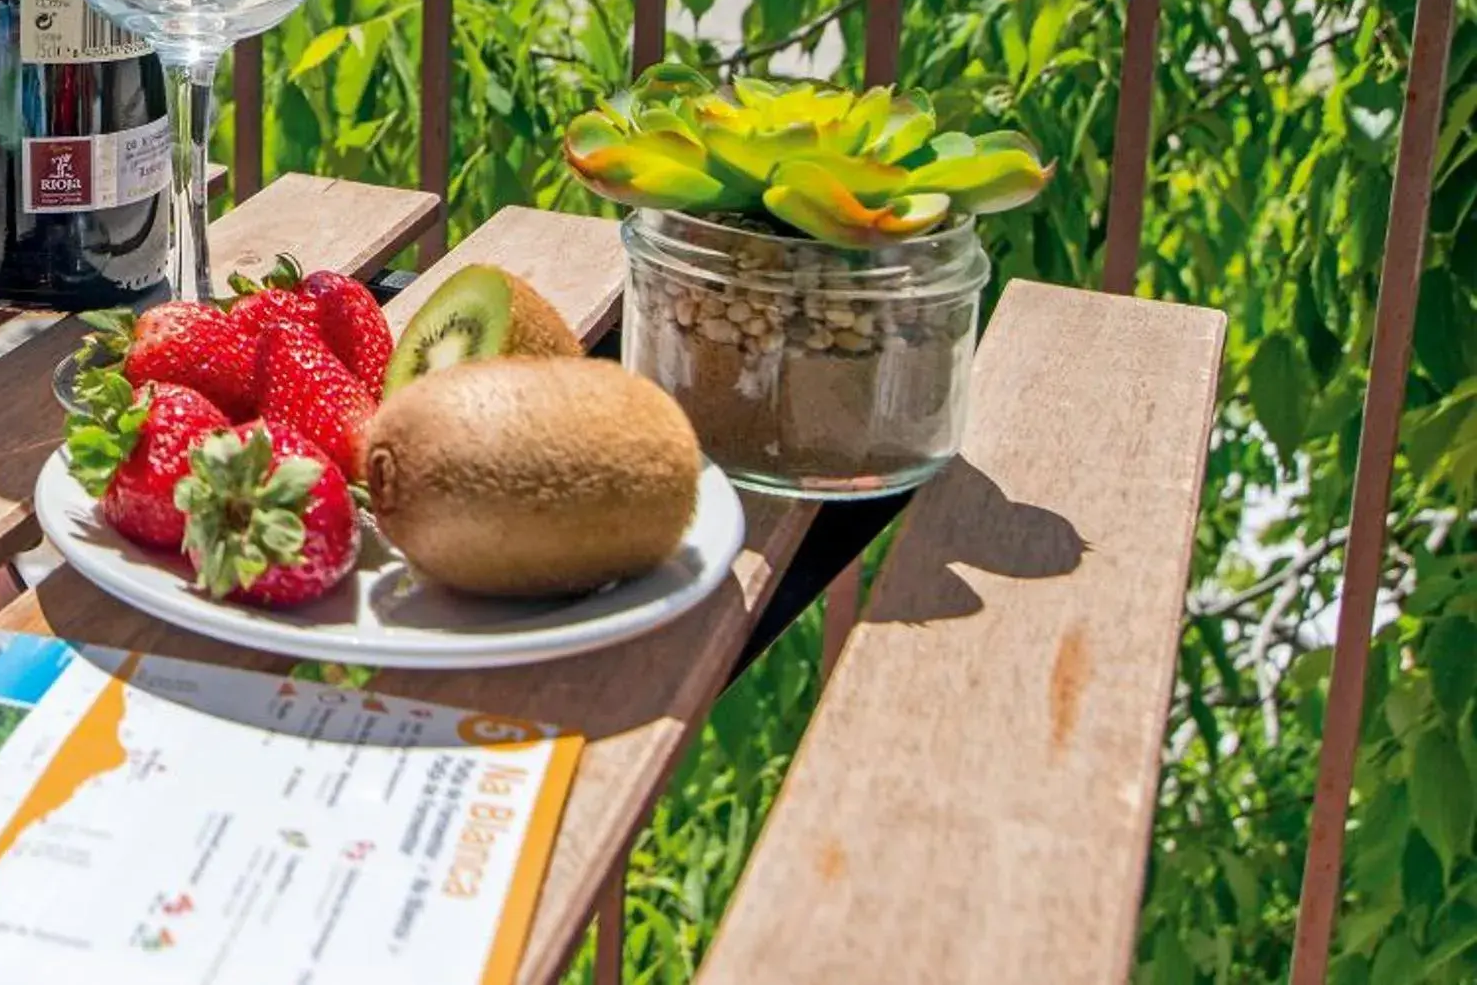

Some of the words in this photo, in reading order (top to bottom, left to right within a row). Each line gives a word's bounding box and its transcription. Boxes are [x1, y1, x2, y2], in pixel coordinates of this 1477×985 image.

[474, 719, 526, 742] 5
[477, 762, 528, 794] Na
[441, 802, 514, 899] Blanca
